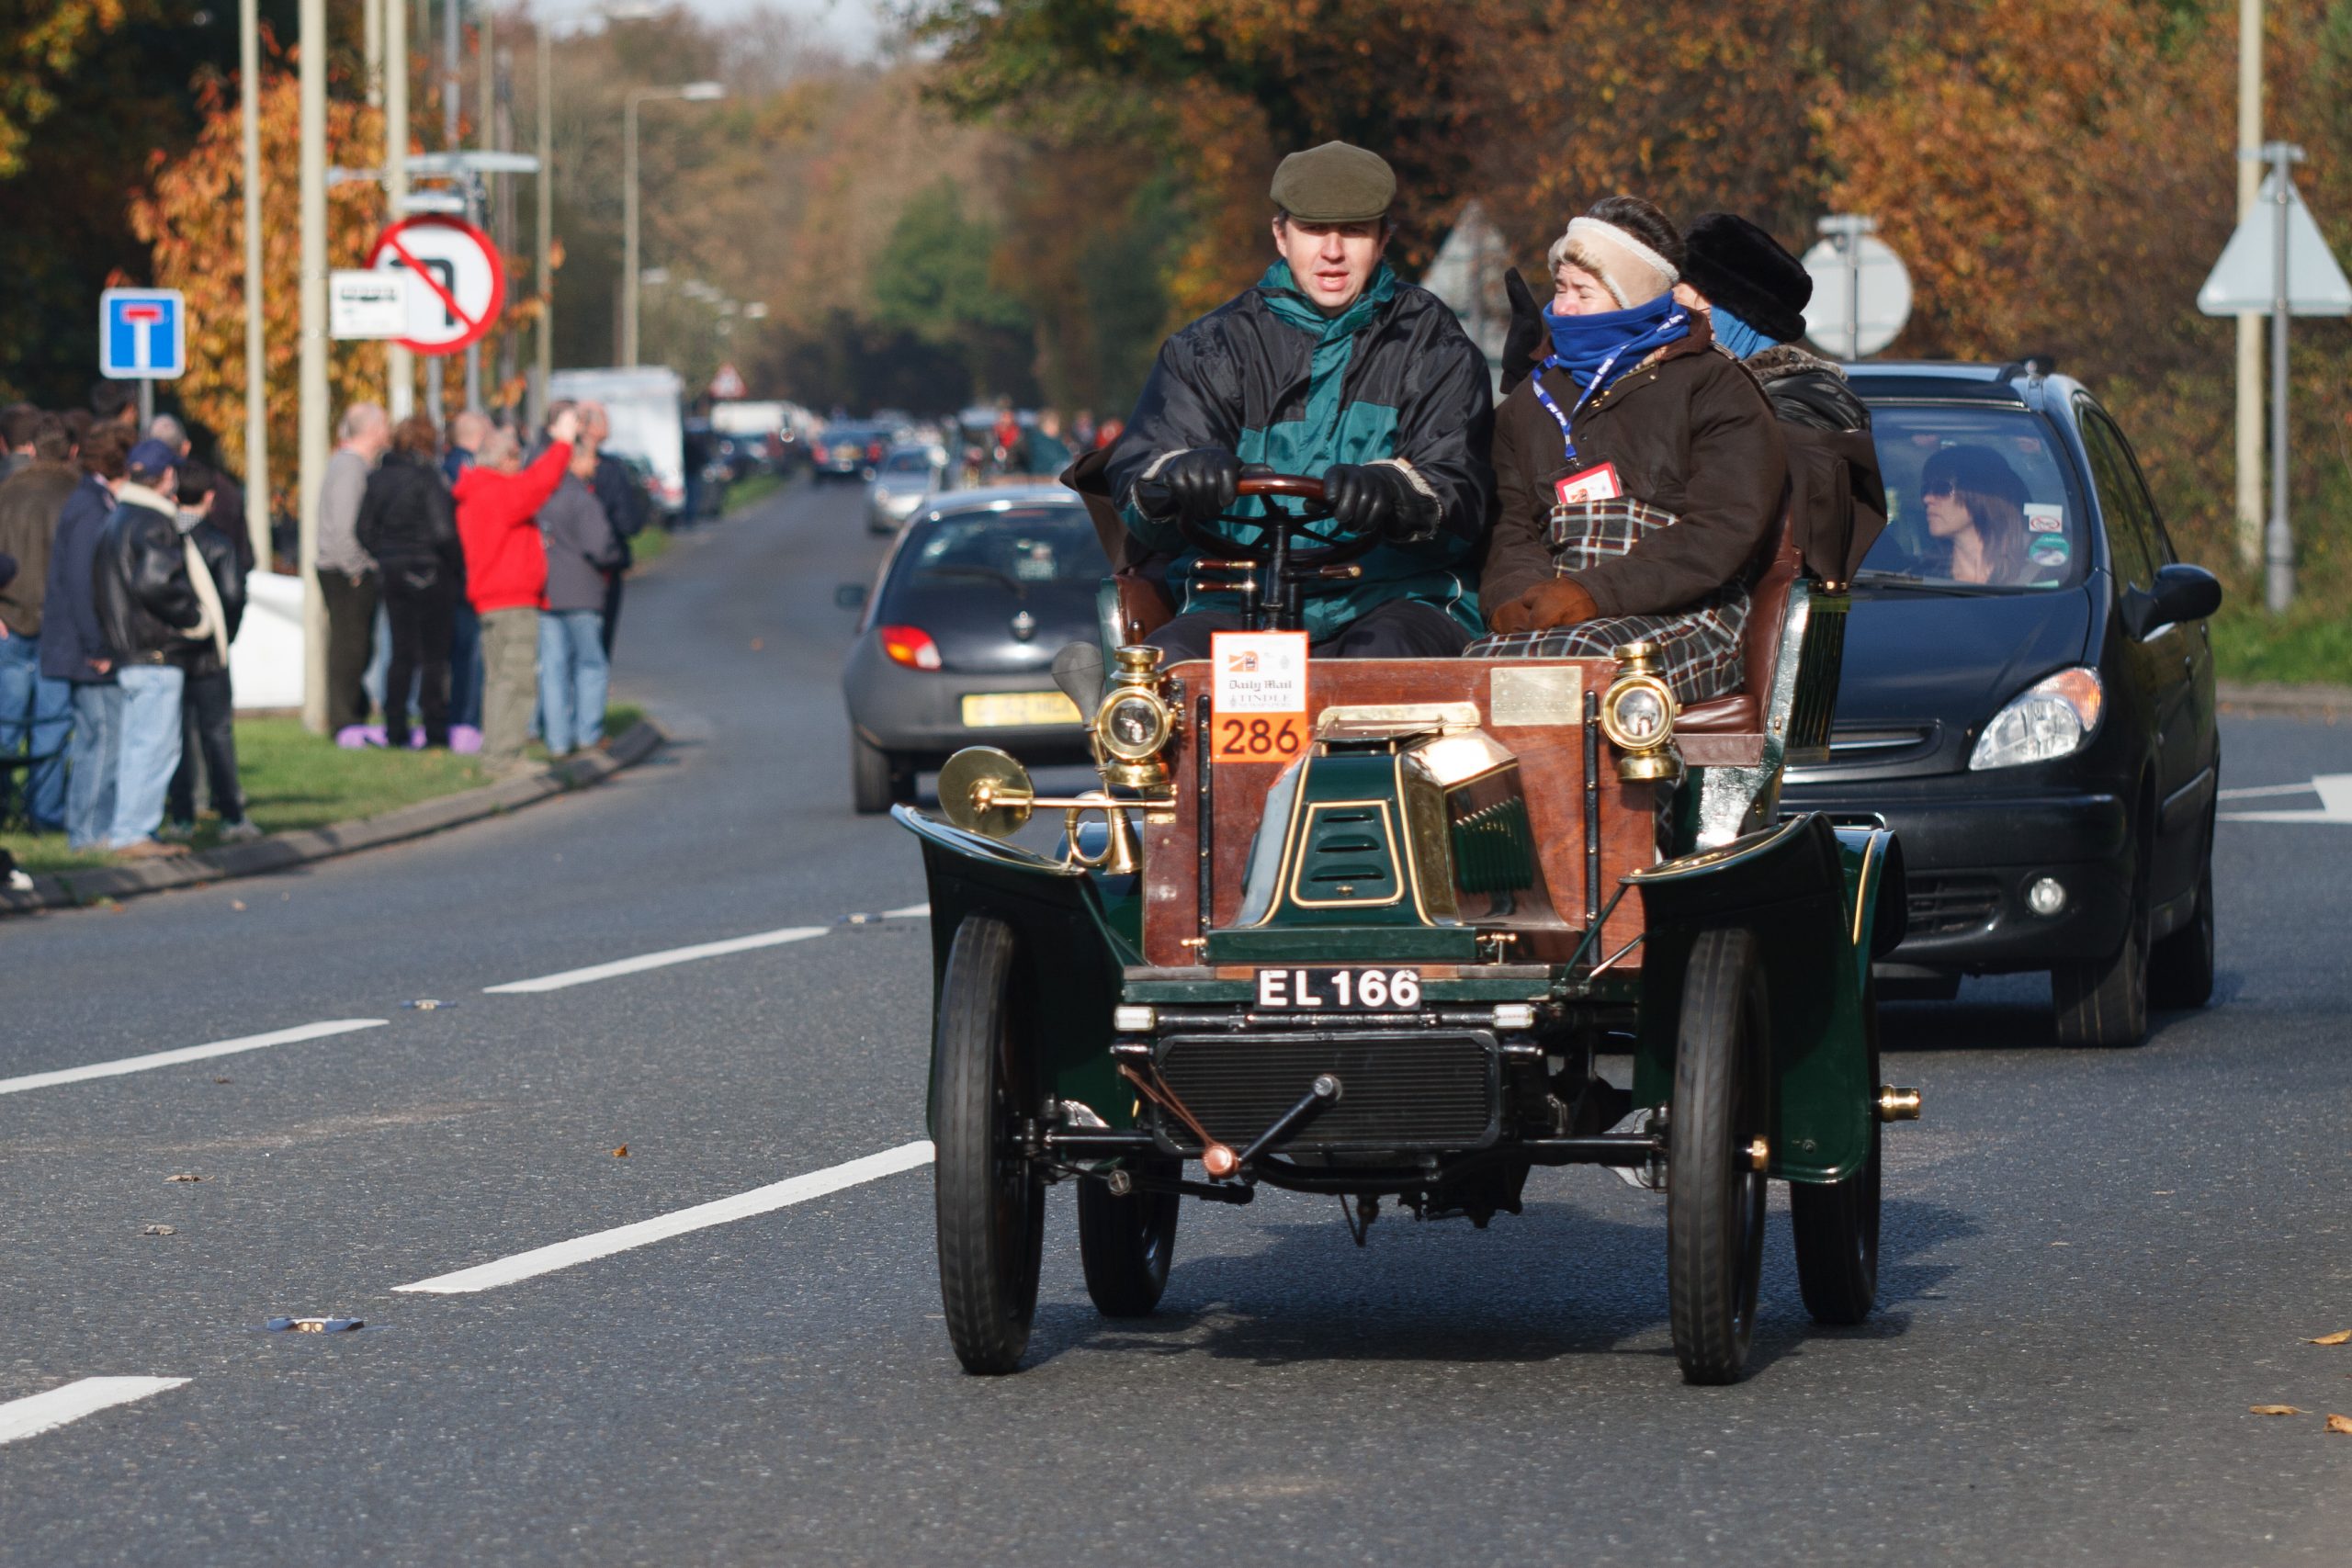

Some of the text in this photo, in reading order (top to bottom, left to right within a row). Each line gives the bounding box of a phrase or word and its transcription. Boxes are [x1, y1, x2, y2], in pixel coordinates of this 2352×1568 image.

[1228, 679, 1293, 692] Daily Mail
[1222, 718, 1299, 755] 286
[1260, 969, 1420, 1008] EL 166
